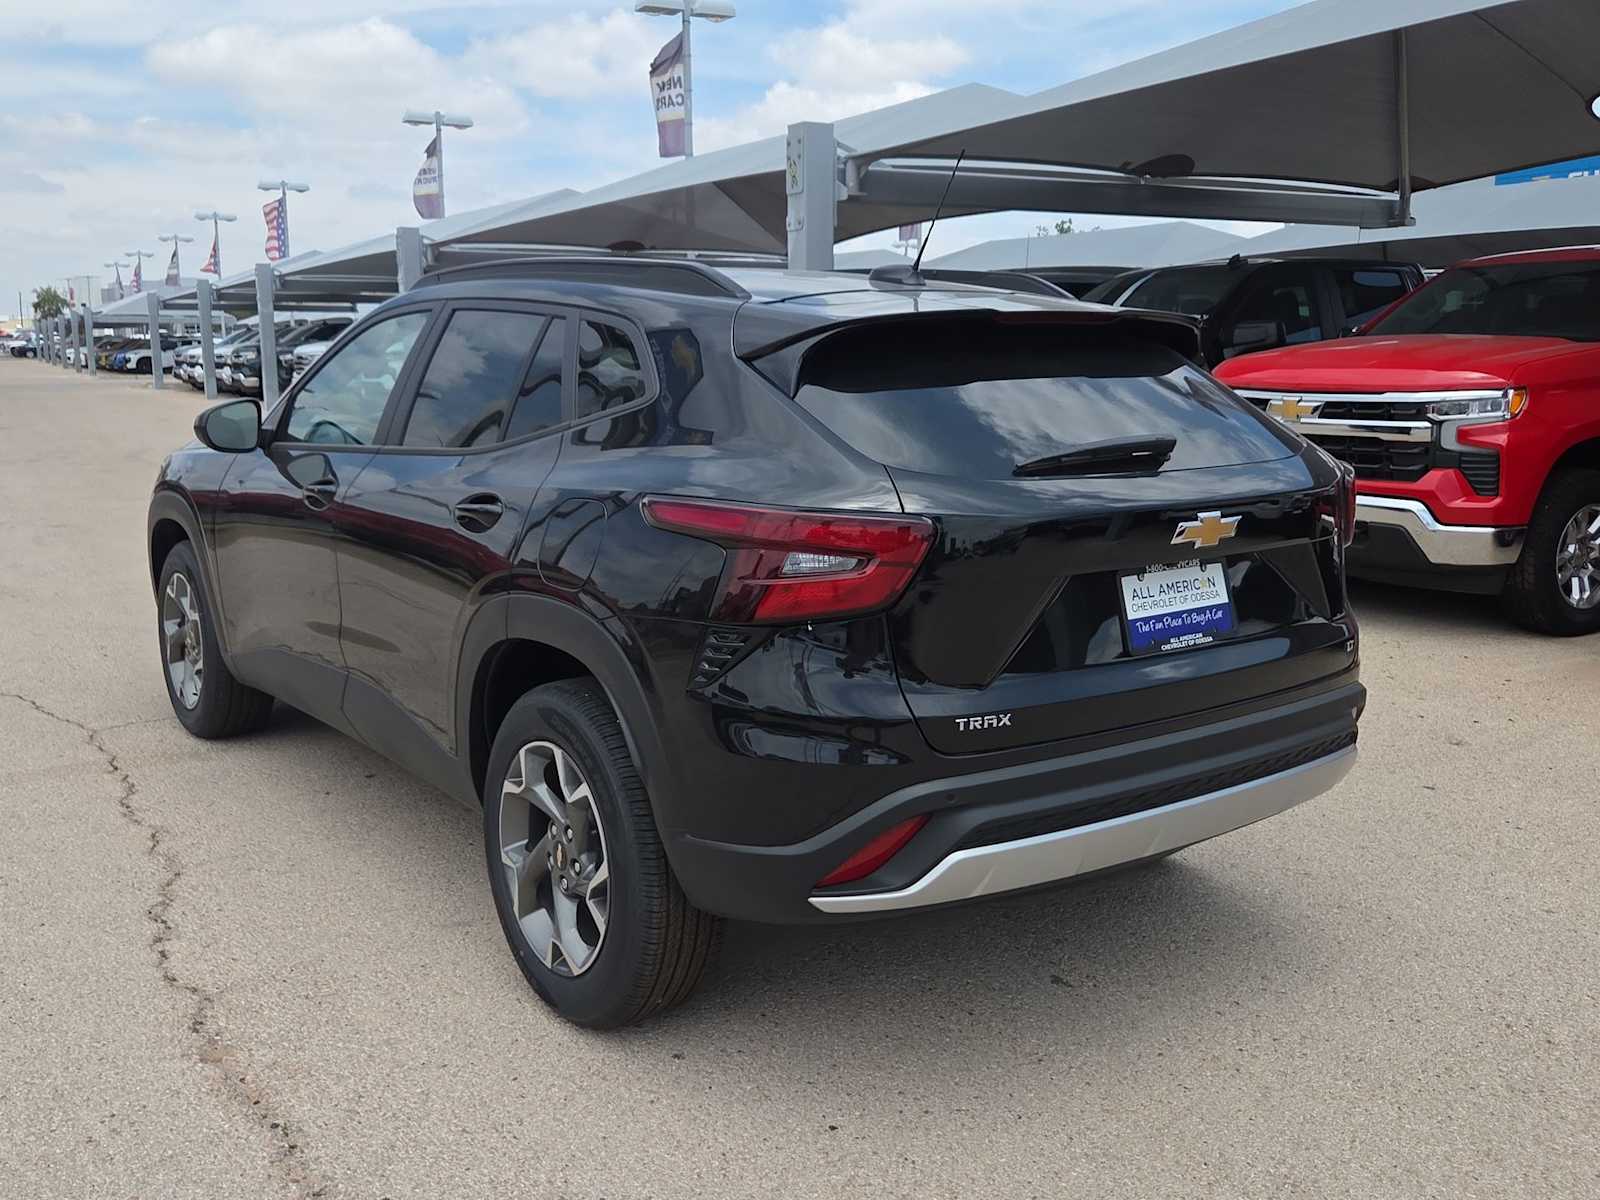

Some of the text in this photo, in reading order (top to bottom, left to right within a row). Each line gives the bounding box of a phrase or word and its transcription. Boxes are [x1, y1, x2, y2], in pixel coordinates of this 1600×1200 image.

[1132, 588, 1155, 601] ALL
[1132, 590, 1221, 612] CHEVROLET OF ODESSA
[1136, 608, 1223, 632] The Fun Place To Buy A Car
[955, 714, 1011, 731] TRAX
